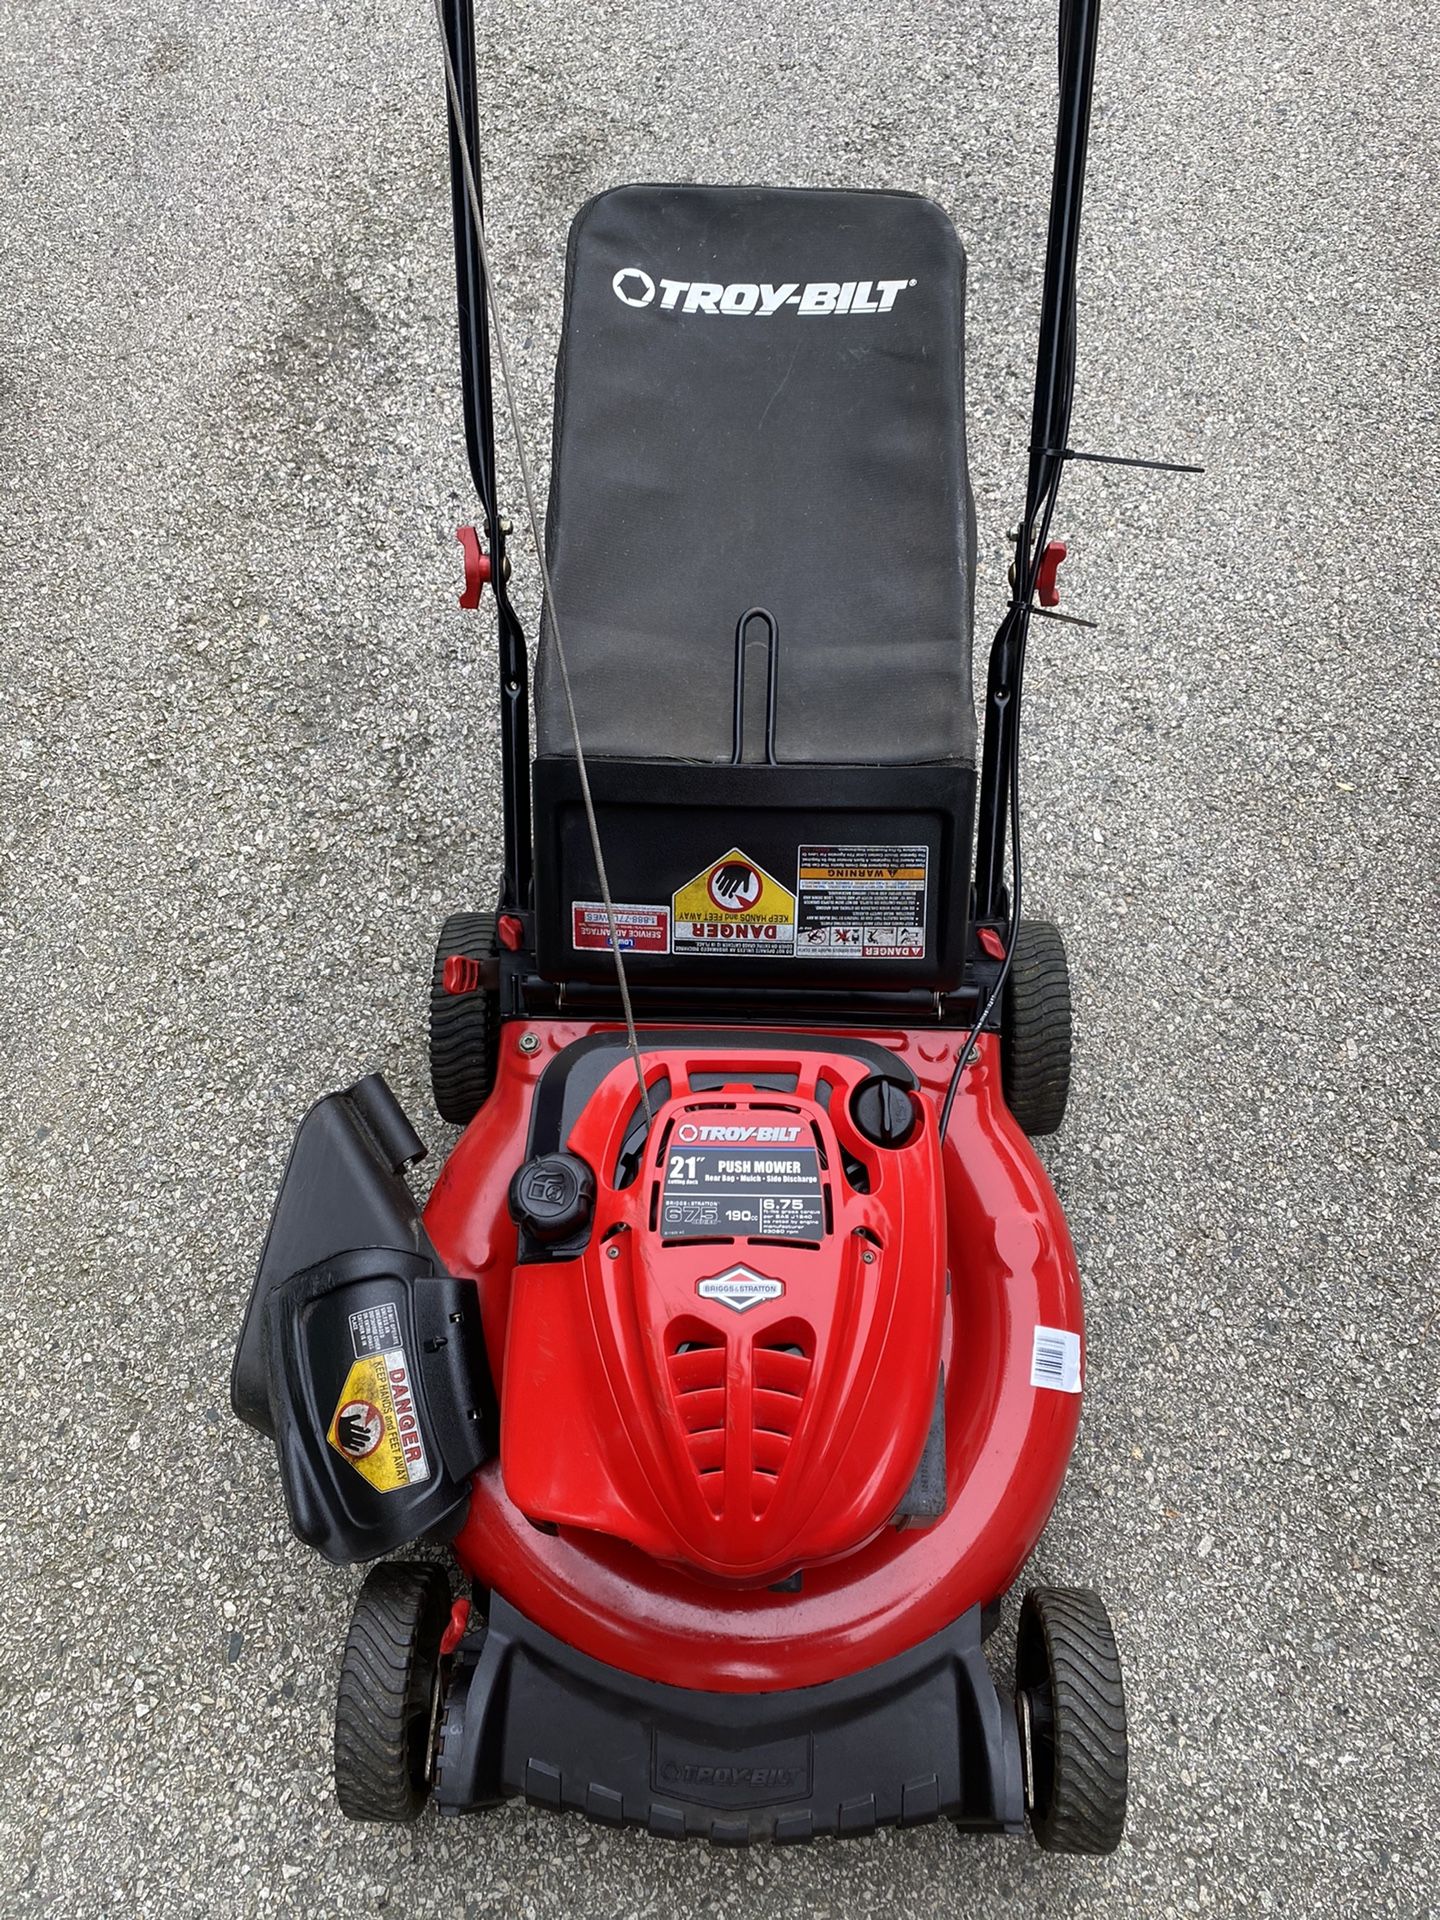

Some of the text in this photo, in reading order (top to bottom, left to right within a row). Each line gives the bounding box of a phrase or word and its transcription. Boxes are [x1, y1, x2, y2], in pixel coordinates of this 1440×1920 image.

[658, 278, 908, 316] TROY-BILT
[827, 869, 884, 877] WARNING
[585, 913, 656, 924] 1-888-77LWES
[679, 912, 789, 923] KEEP HANDS and FEET AWAY
[581, 927, 627, 937] ADANTAGE
[628, 929, 662, 939] SERVICE
[692, 923, 777, 939] DANGER
[865, 947, 909, 955] DANGER
[699, 1126, 801, 1142] TROY-BILT
[718, 1160, 801, 1174] PUSH MOWER
[705, 1174, 721, 1182] Rear
[722, 1175, 738, 1183] Bag
[782, 1175, 818, 1183] Discharge
[763, 1199, 803, 1210] 6.75
[664, 1206, 719, 1222] 675
[389, 1367, 423, 1463] DANGER
[374, 1361, 408, 1481] KEEP HANDS and FEET AWAY
